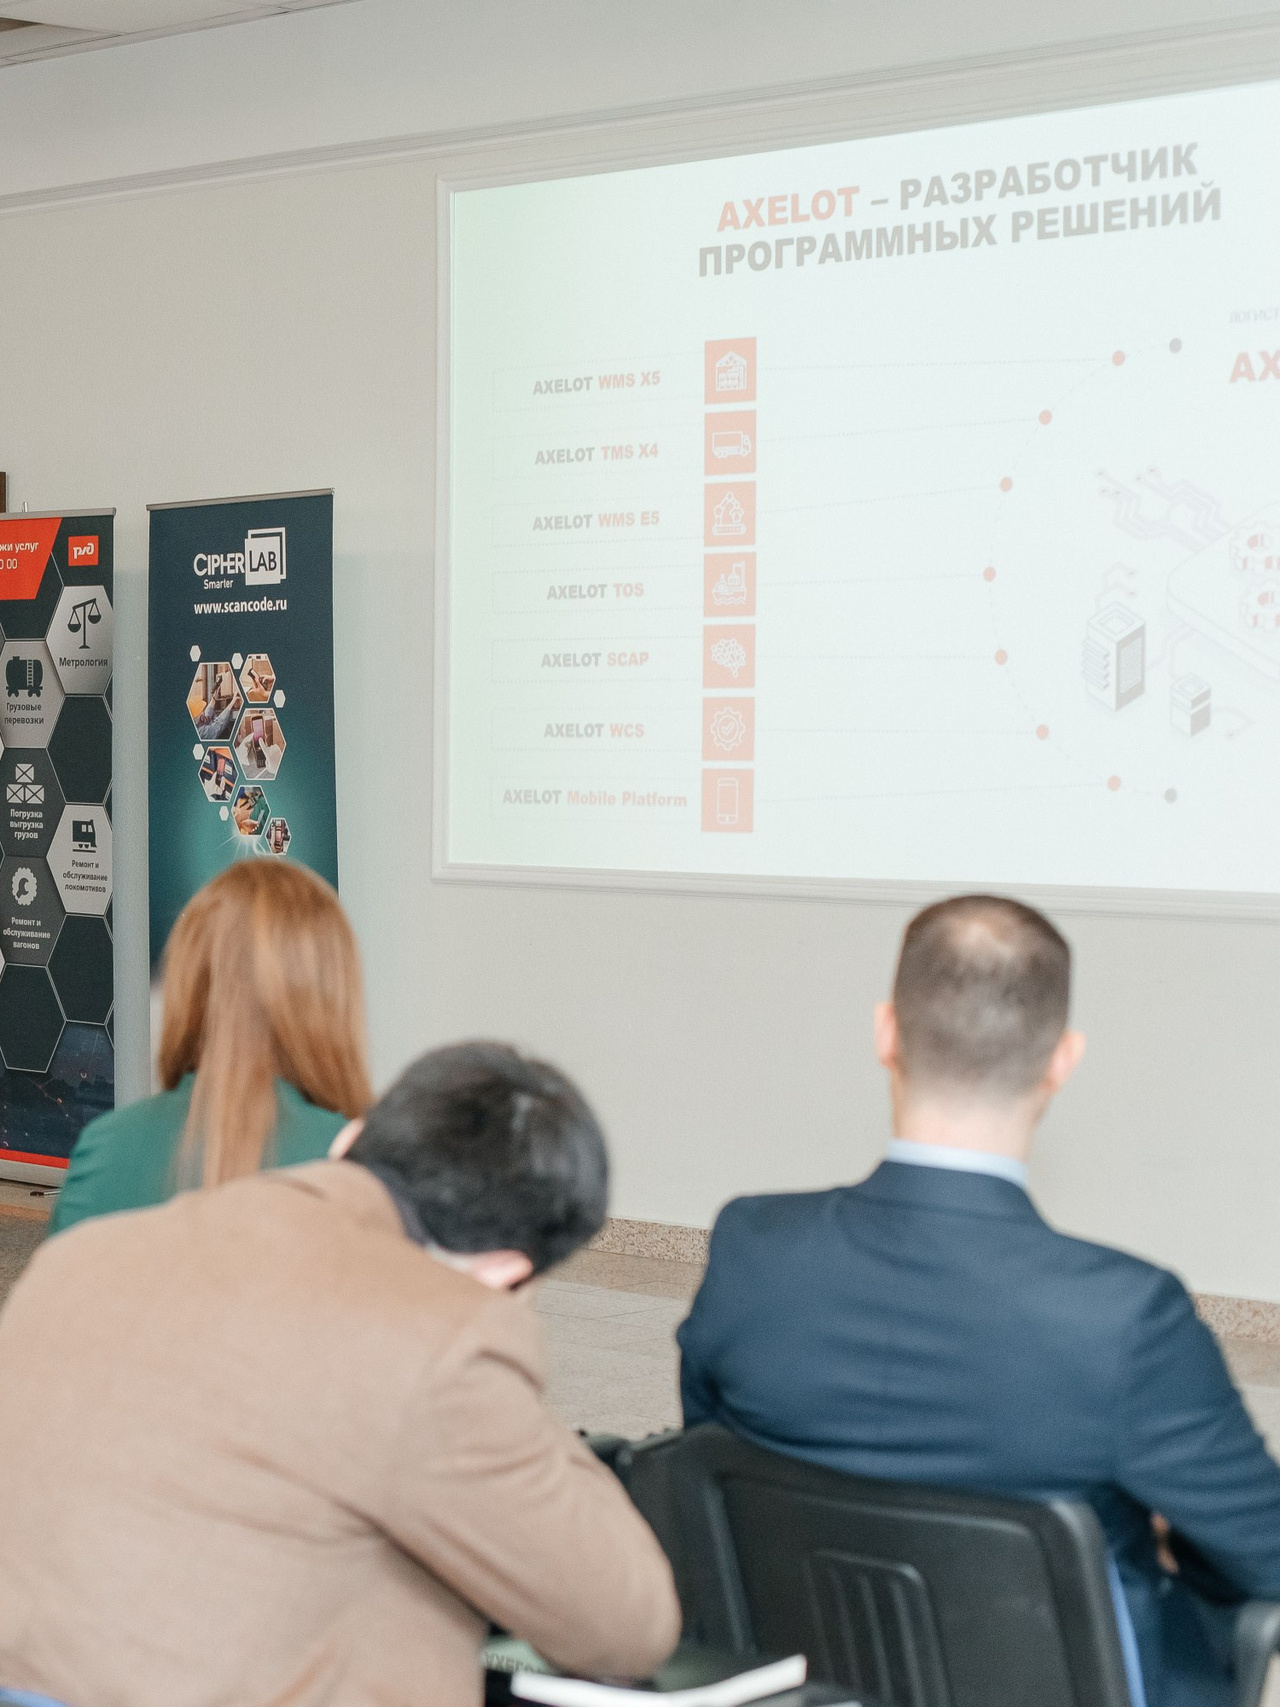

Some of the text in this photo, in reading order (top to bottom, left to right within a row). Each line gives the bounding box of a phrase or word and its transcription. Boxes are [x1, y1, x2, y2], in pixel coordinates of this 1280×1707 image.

[717, 186, 860, 232] AXELOT
[900, 142, 1198, 210] РАЗРАБОТЧИК
[699, 180, 1221, 277] ПРОГРАММНЫХ РЕШЕНИЙ
[533, 370, 661, 395] AXELOT WMS X5
[535, 443, 659, 465] AXELOT TMS X4
[533, 510, 660, 531] AXELOT WMS E5
[14, 542, 39, 553] услуг
[6, 558, 18, 569] 00
[203, 579, 234, 590] Smarter
[547, 582, 644, 600] AXELOT TOS
[194, 596, 288, 615] www.scancode.ru
[59, 657, 108, 669] Метрология
[541, 652, 649, 668] AXELOT SCAP
[6, 703, 42, 712] Грузовые
[4, 716, 44, 726] перевозки
[544, 723, 645, 738] AXELOT WCS
[502, 790, 688, 807] AXELOT Mobile Platform
[10, 809, 43, 819] Погрузка
[9, 821, 44, 830] выгрузка
[14, 831, 39, 840] грузов
[71, 860, 94, 869] Ремонт
[62, 871, 108, 882] обслуживание
[64, 883, 107, 893] локомотивов
[11, 917, 36, 927] Ремонт
[2, 928, 51, 939] обслуживание
[12, 941, 40, 950] вагонов
